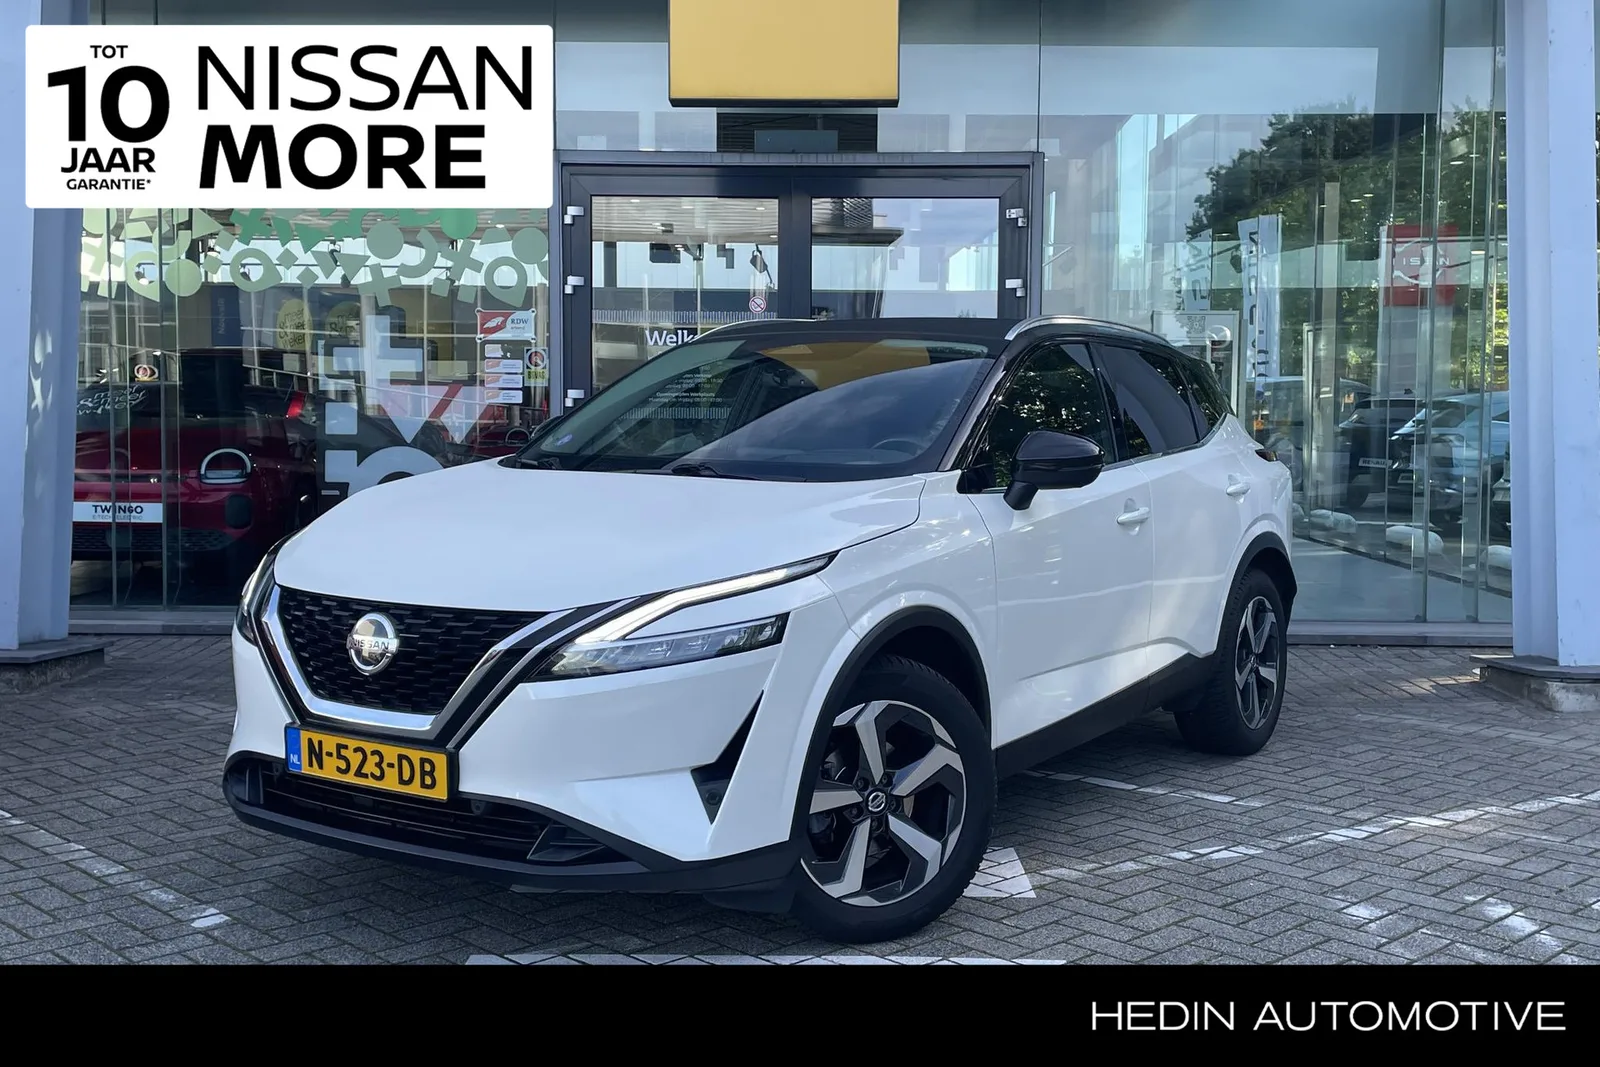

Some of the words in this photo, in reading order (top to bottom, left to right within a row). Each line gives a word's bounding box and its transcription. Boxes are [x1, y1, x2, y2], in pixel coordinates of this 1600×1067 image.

[645, 330, 698, 346] Welk
[92, 505, 144, 514] TWINGO
[350, 637, 389, 651] NISSAN
[290, 752, 300, 765] NL
[307, 737, 437, 790] N-523-DB
